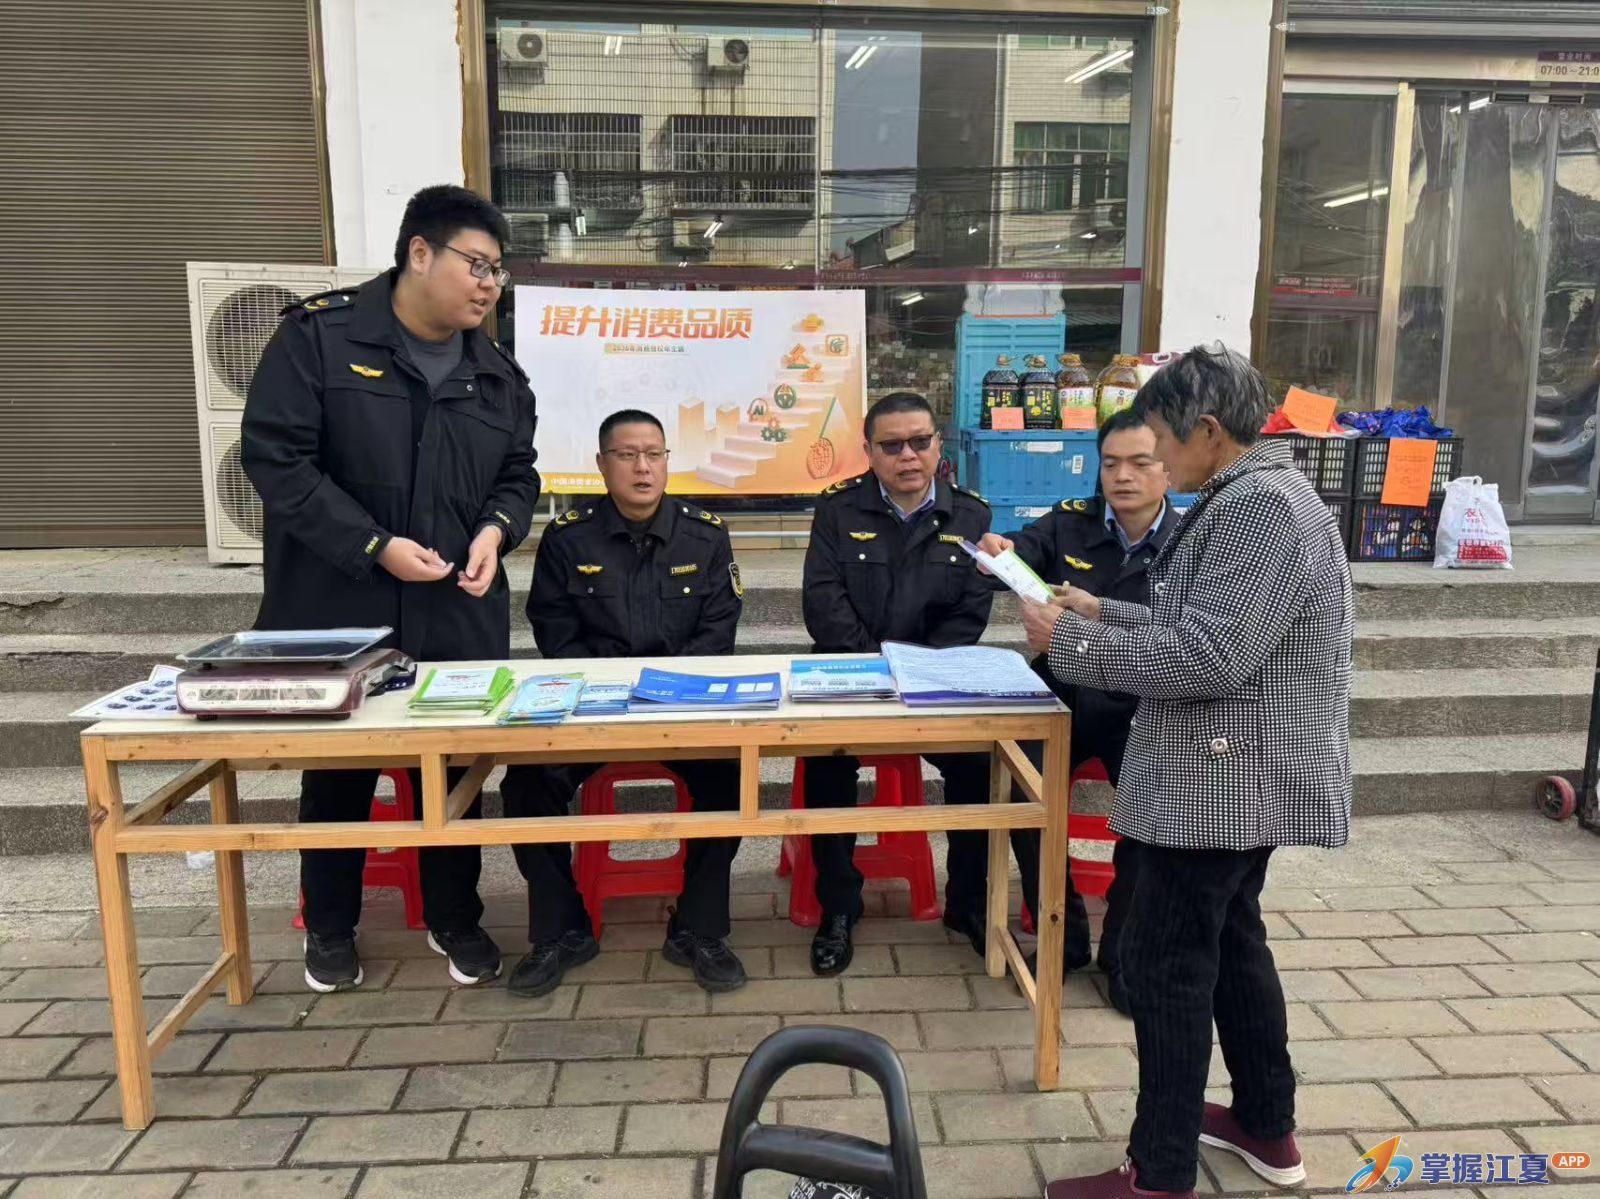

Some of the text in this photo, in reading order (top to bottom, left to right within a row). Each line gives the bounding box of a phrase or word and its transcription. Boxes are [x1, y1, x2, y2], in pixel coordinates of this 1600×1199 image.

[539, 304, 753, 339] 提升消费品质
[551, 477, 605, 487] 中国消费者协
